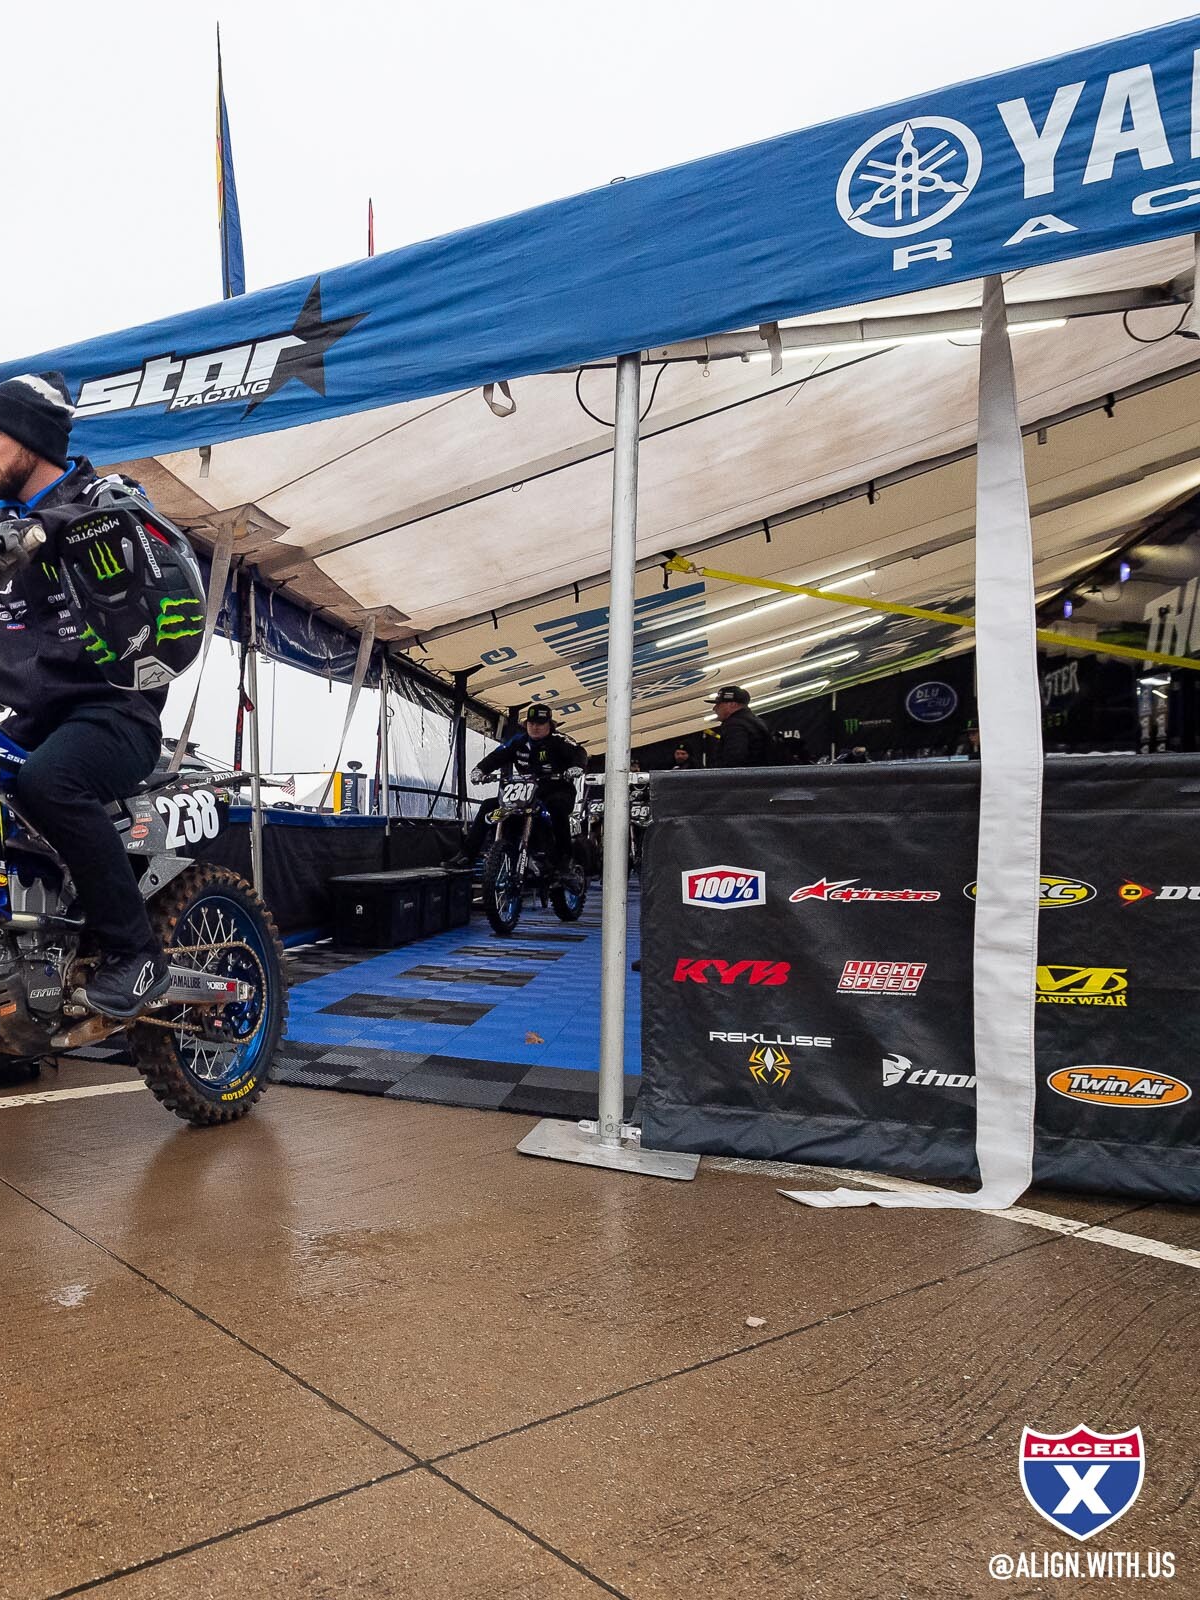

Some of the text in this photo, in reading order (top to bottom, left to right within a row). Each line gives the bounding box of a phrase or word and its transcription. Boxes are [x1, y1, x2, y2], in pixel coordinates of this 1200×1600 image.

[997, 46, 1200, 199] YA
[169, 379, 270, 410] RACING
[65, 518, 120, 545] MONSTER
[156, 789, 220, 850] 238
[693, 876, 754, 900] 100%
[829, 887, 941, 903] alpinestars
[672, 958, 792, 986] KYB
[845, 961, 925, 976] LIGHT
[840, 976, 919, 989] SPEED
[1035, 994, 1128, 1007] ANIX WEAR
[709, 1031, 832, 1048] REKLUSE
[221, 1078, 255, 1101] DUNLOP
[1069, 1073, 1173, 1096] Twin Air
